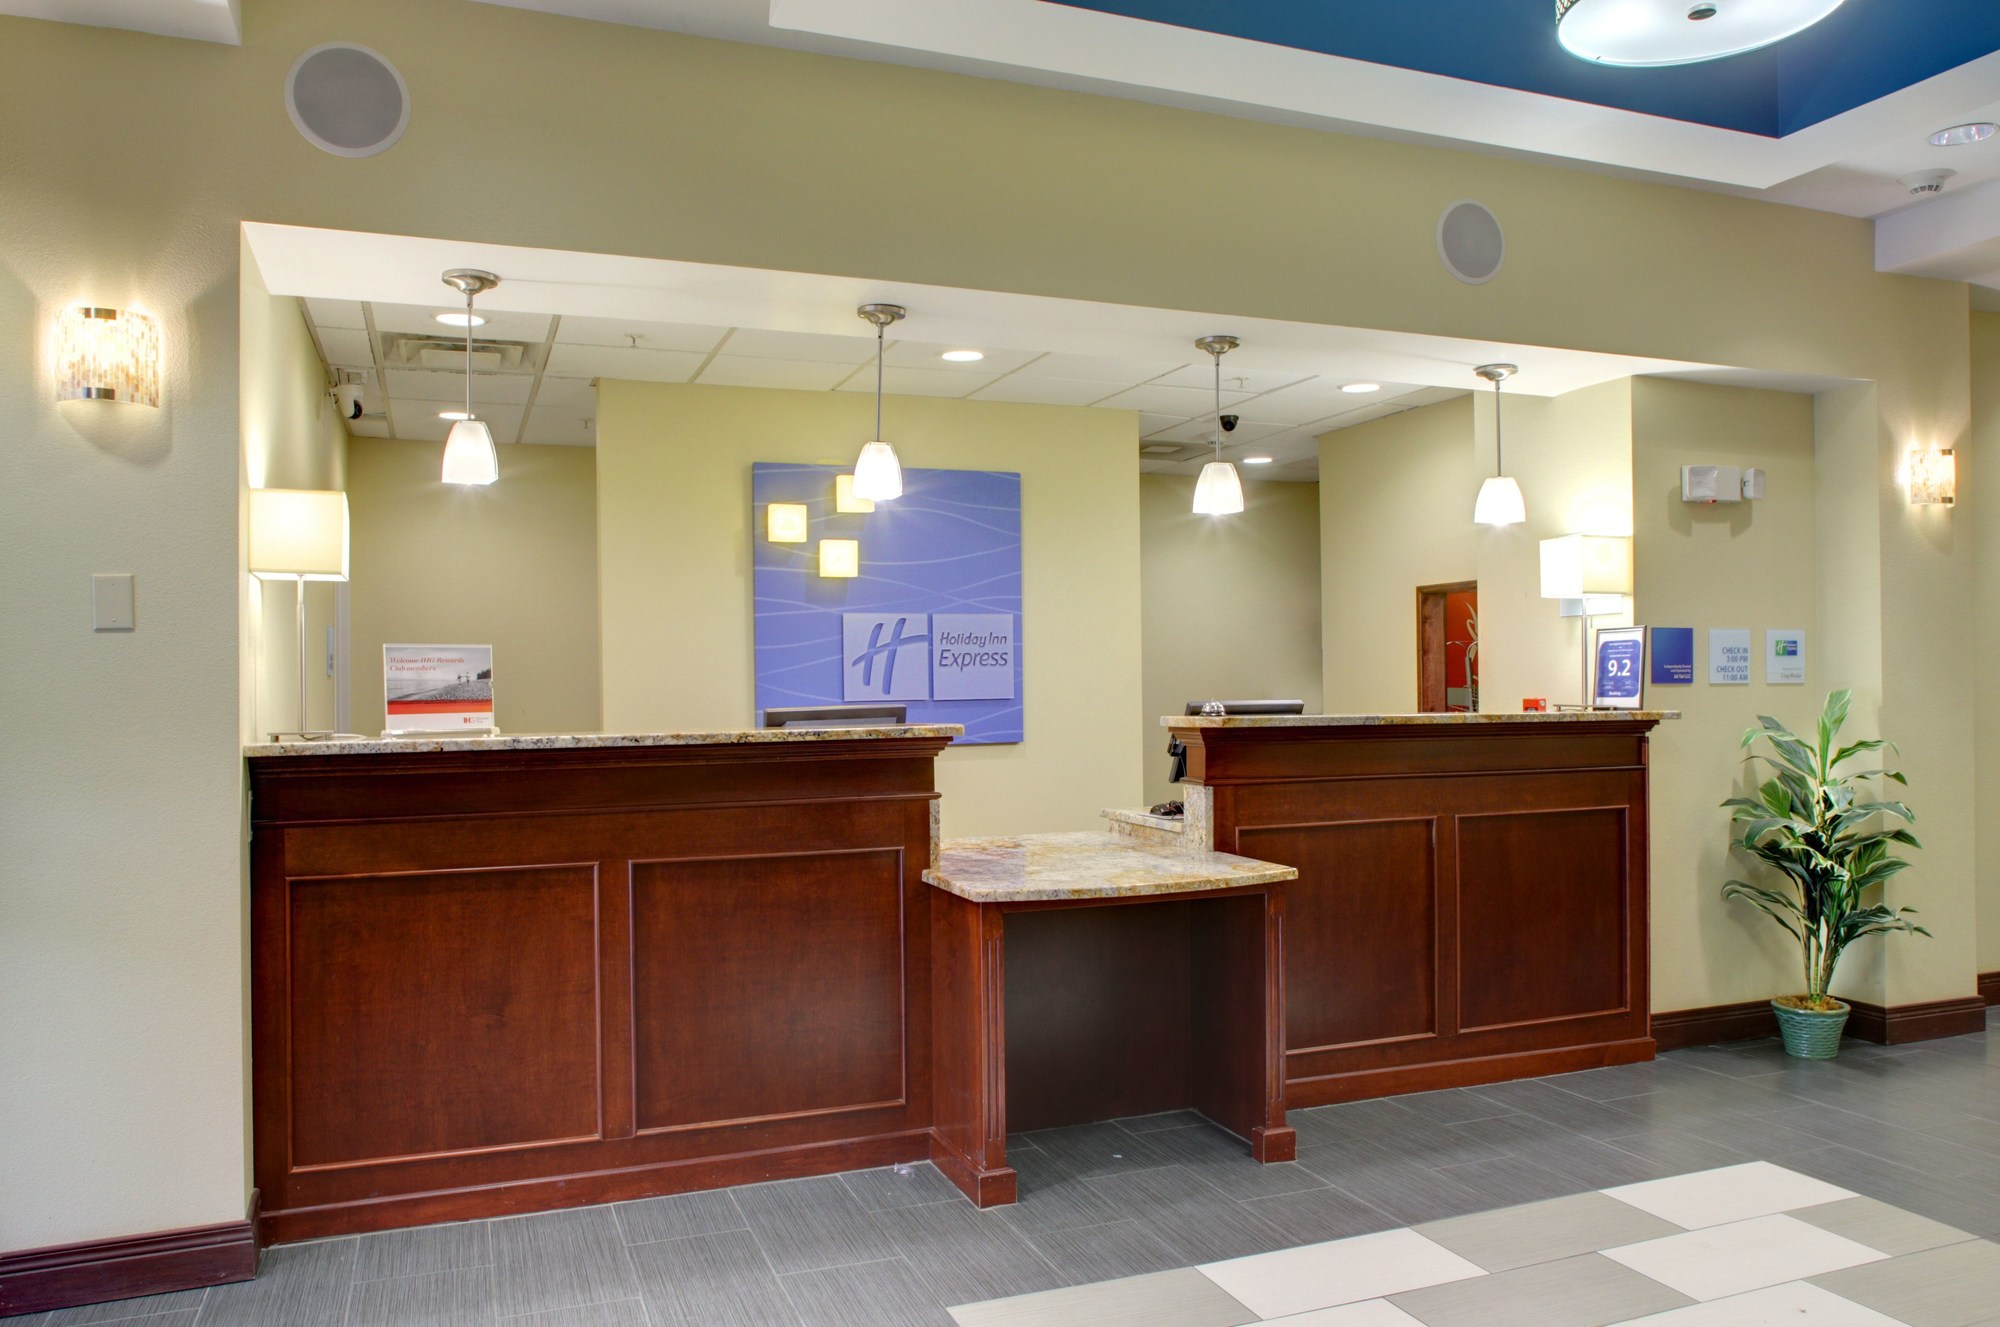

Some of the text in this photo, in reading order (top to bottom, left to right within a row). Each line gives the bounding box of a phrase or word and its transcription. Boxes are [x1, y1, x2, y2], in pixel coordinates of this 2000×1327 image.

[939, 631, 1007, 648] Holiday Inn
[390, 656, 418, 664] Welcome
[437, 656, 465, 664] Rewards
[938, 649, 1008, 672] Express
[1608, 659, 1631, 677] 9.2
[1716, 665, 1748, 673] CHECK OUT
